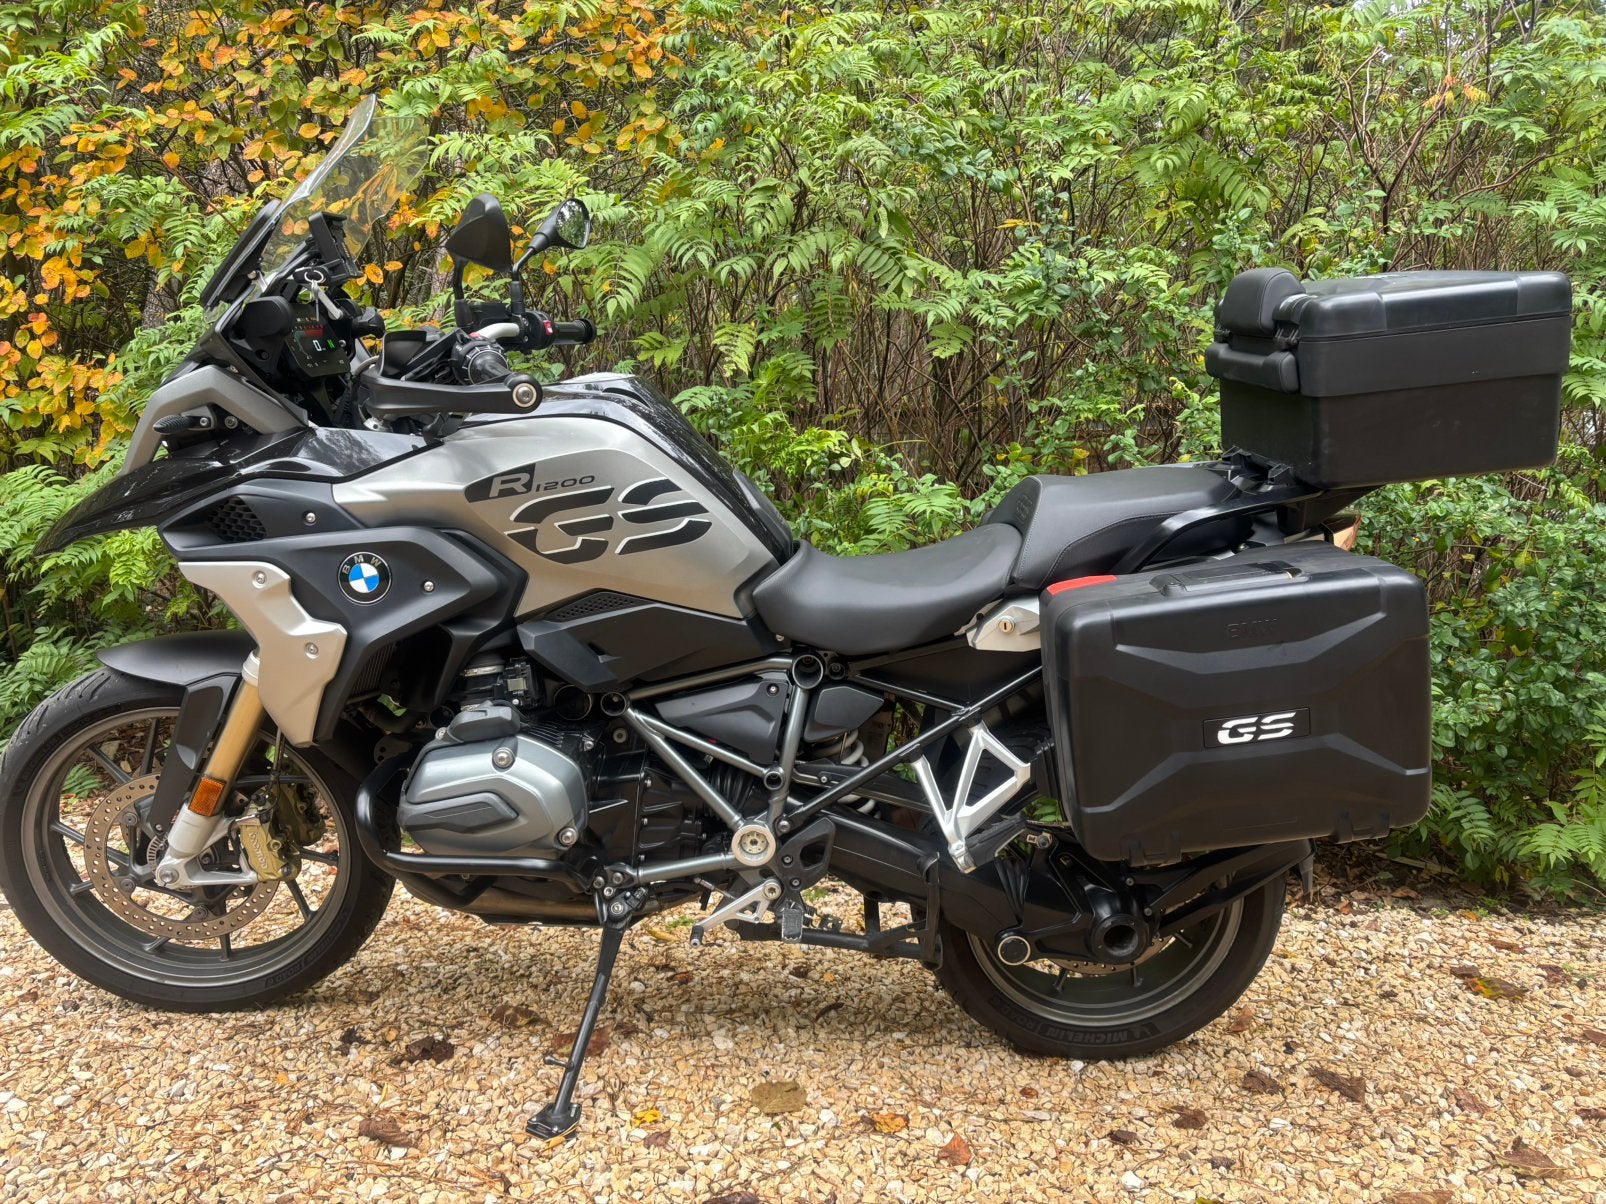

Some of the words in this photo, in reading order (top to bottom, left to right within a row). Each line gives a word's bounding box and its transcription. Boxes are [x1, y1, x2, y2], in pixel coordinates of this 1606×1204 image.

[504, 477, 713, 564] GS
[342, 554, 381, 575] BMW
[1217, 712, 1296, 744] GS
[1045, 1027, 1129, 1043] MICHELIN
